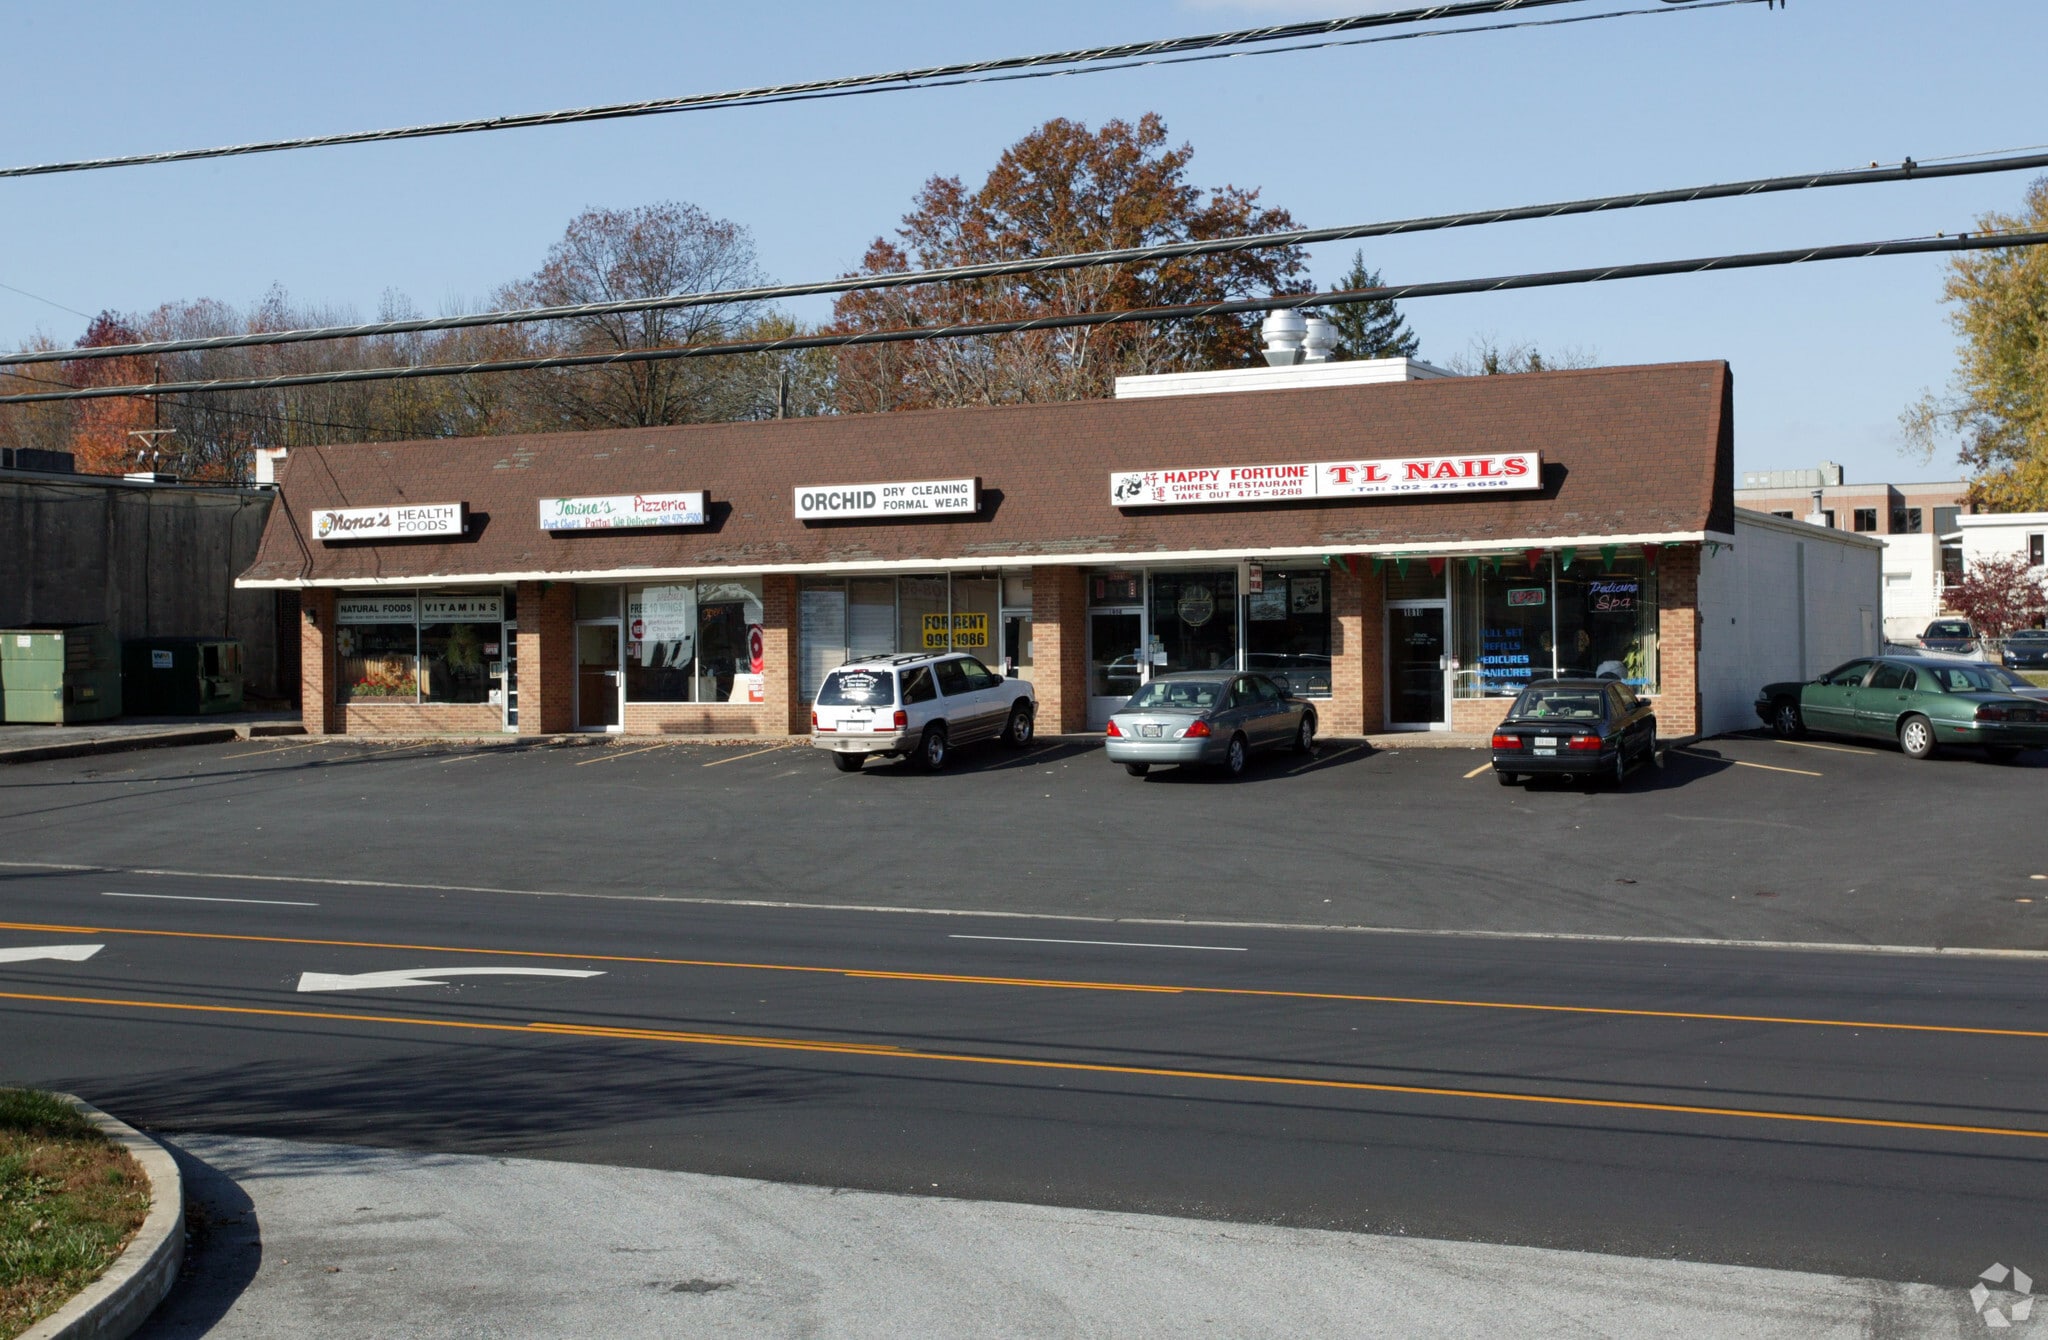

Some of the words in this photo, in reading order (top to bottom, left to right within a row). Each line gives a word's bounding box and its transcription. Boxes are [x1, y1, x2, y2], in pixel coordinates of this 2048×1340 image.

[1164, 470, 1220, 483] HAPPY
[1231, 465, 1309, 480] FORTUNE
[1327, 464, 1391, 485] TL
[1403, 457, 1529, 482] NAILS
[883, 487, 905, 497] DRY
[912, 484, 969, 496] CLEANING
[1172, 482, 1219, 492] CHINESE
[1229, 479, 1303, 489] RESTAURANT
[801, 490, 877, 511] ORCHID
[1175, 492, 1202, 501] TAKE
[1209, 490, 1231, 499] OUT
[1236, 487, 1303, 498] 475-8288
[634, 494, 687, 513] Pizzeria
[884, 500, 928, 511] FORMAL
[934, 497, 969, 508] WEAR
[397, 508, 454, 521] HEALTH
[319, 512, 392, 537] Mona's
[397, 519, 448, 532] FOODS
[1589, 581, 1638, 596] Pedicure
[340, 604, 379, 613] NATURAL
[382, 603, 413, 612] FOODS
[424, 602, 498, 612] VITAMINS
[630, 603, 648, 614] FREE
[1596, 594, 1632, 612] Spa
[924, 615, 950, 630] FOR
[953, 614, 985, 629] RENT
[926, 632, 985, 647] 999-1986
[1505, 628, 1524, 638] SET
